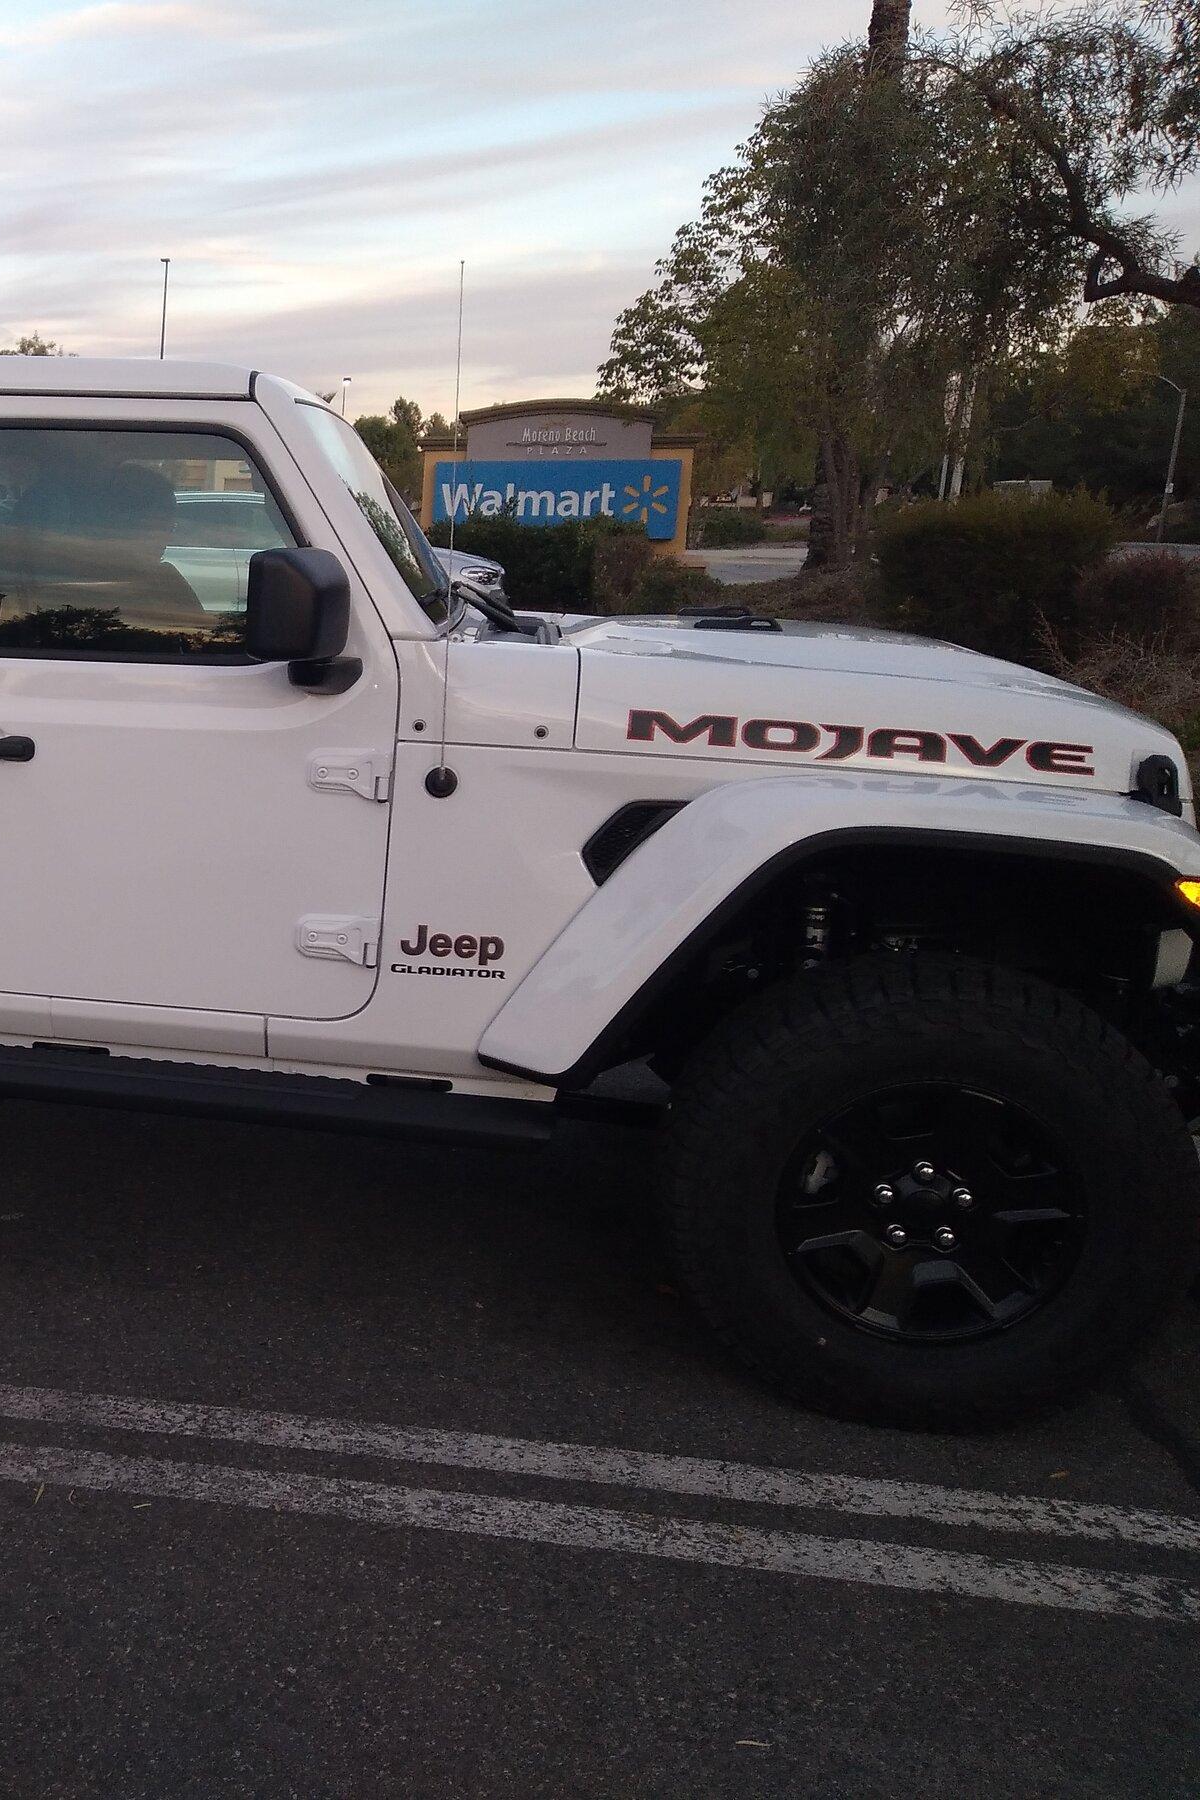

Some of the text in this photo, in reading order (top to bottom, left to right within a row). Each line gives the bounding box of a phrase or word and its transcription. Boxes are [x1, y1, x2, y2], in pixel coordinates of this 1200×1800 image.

[522, 426, 596, 442] Moreno Beach
[527, 446, 587, 455] PLAZA
[442, 483, 615, 517] Walmart
[626, 708, 1094, 776] MOJAVE
[400, 924, 504, 966] Jeep
[390, 963, 506, 980] GLADIATOR
